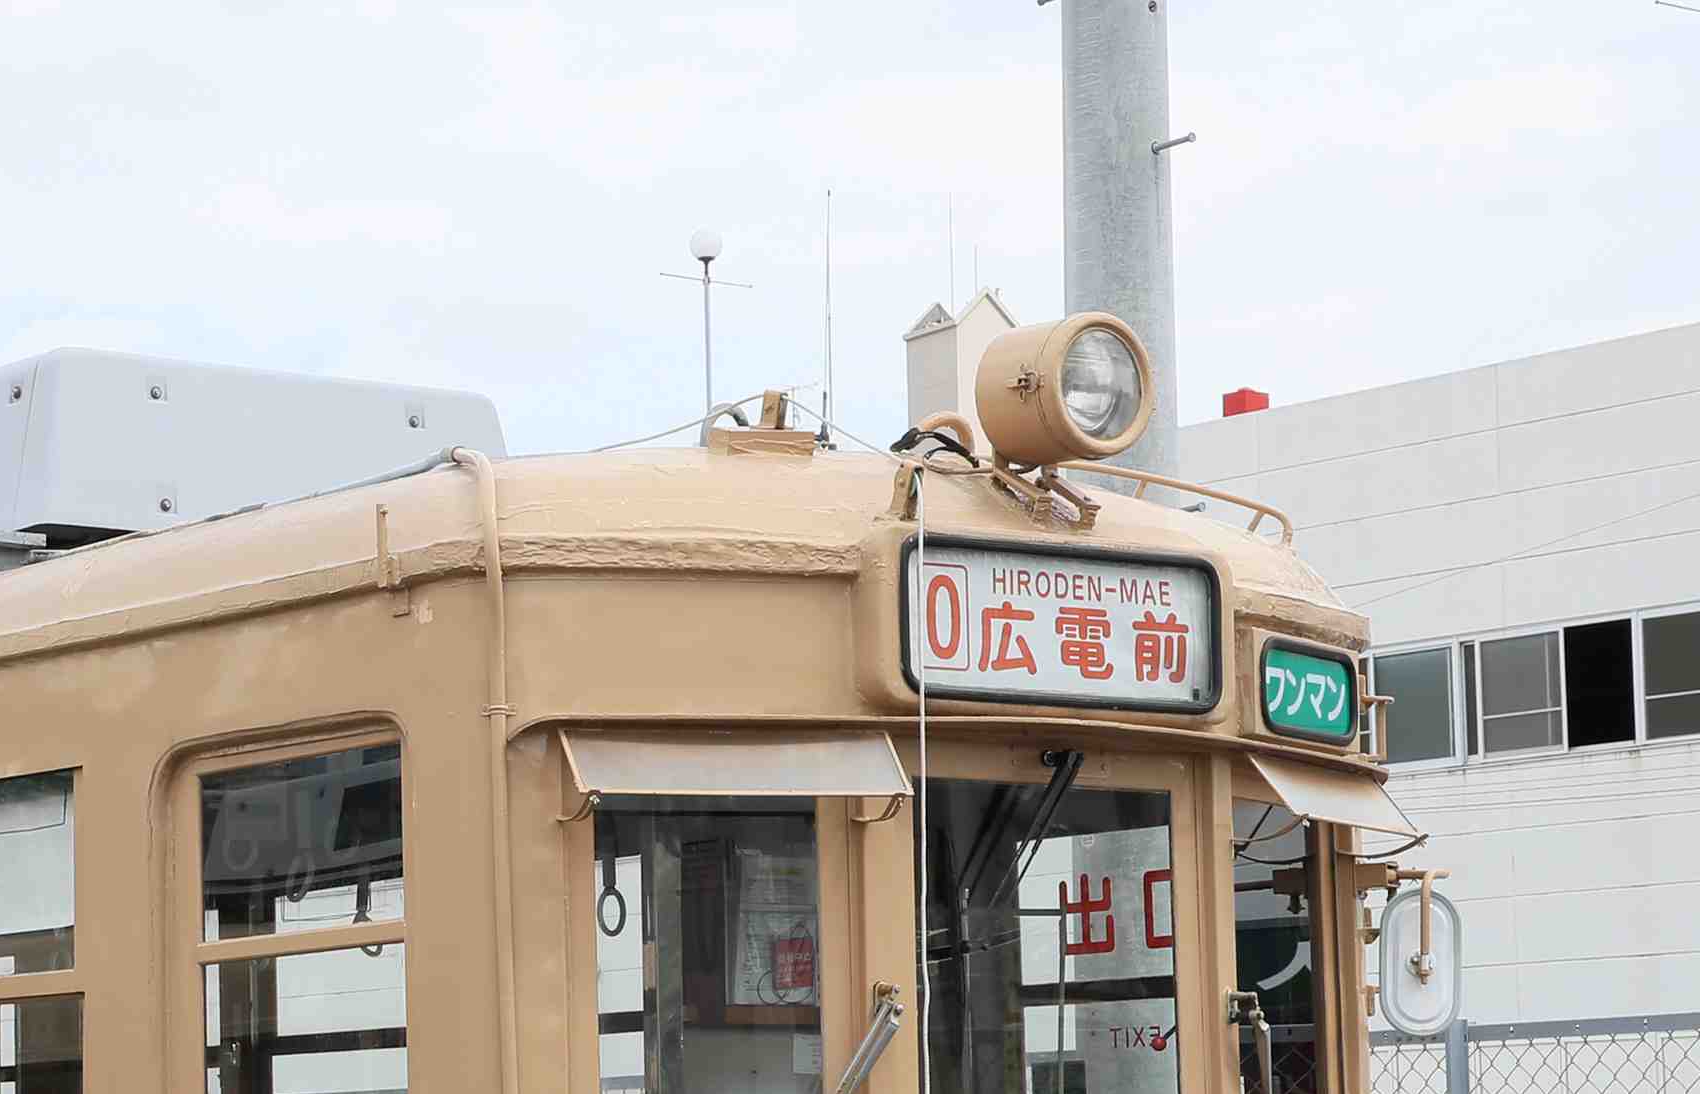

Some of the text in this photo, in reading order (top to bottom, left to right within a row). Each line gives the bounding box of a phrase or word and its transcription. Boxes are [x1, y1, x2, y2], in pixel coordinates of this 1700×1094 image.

[992, 567, 1172, 607] HIRODEN-MAE
[926, 574, 1189, 683] 0 広電前
[1266, 666, 1346, 721] ワンマン
